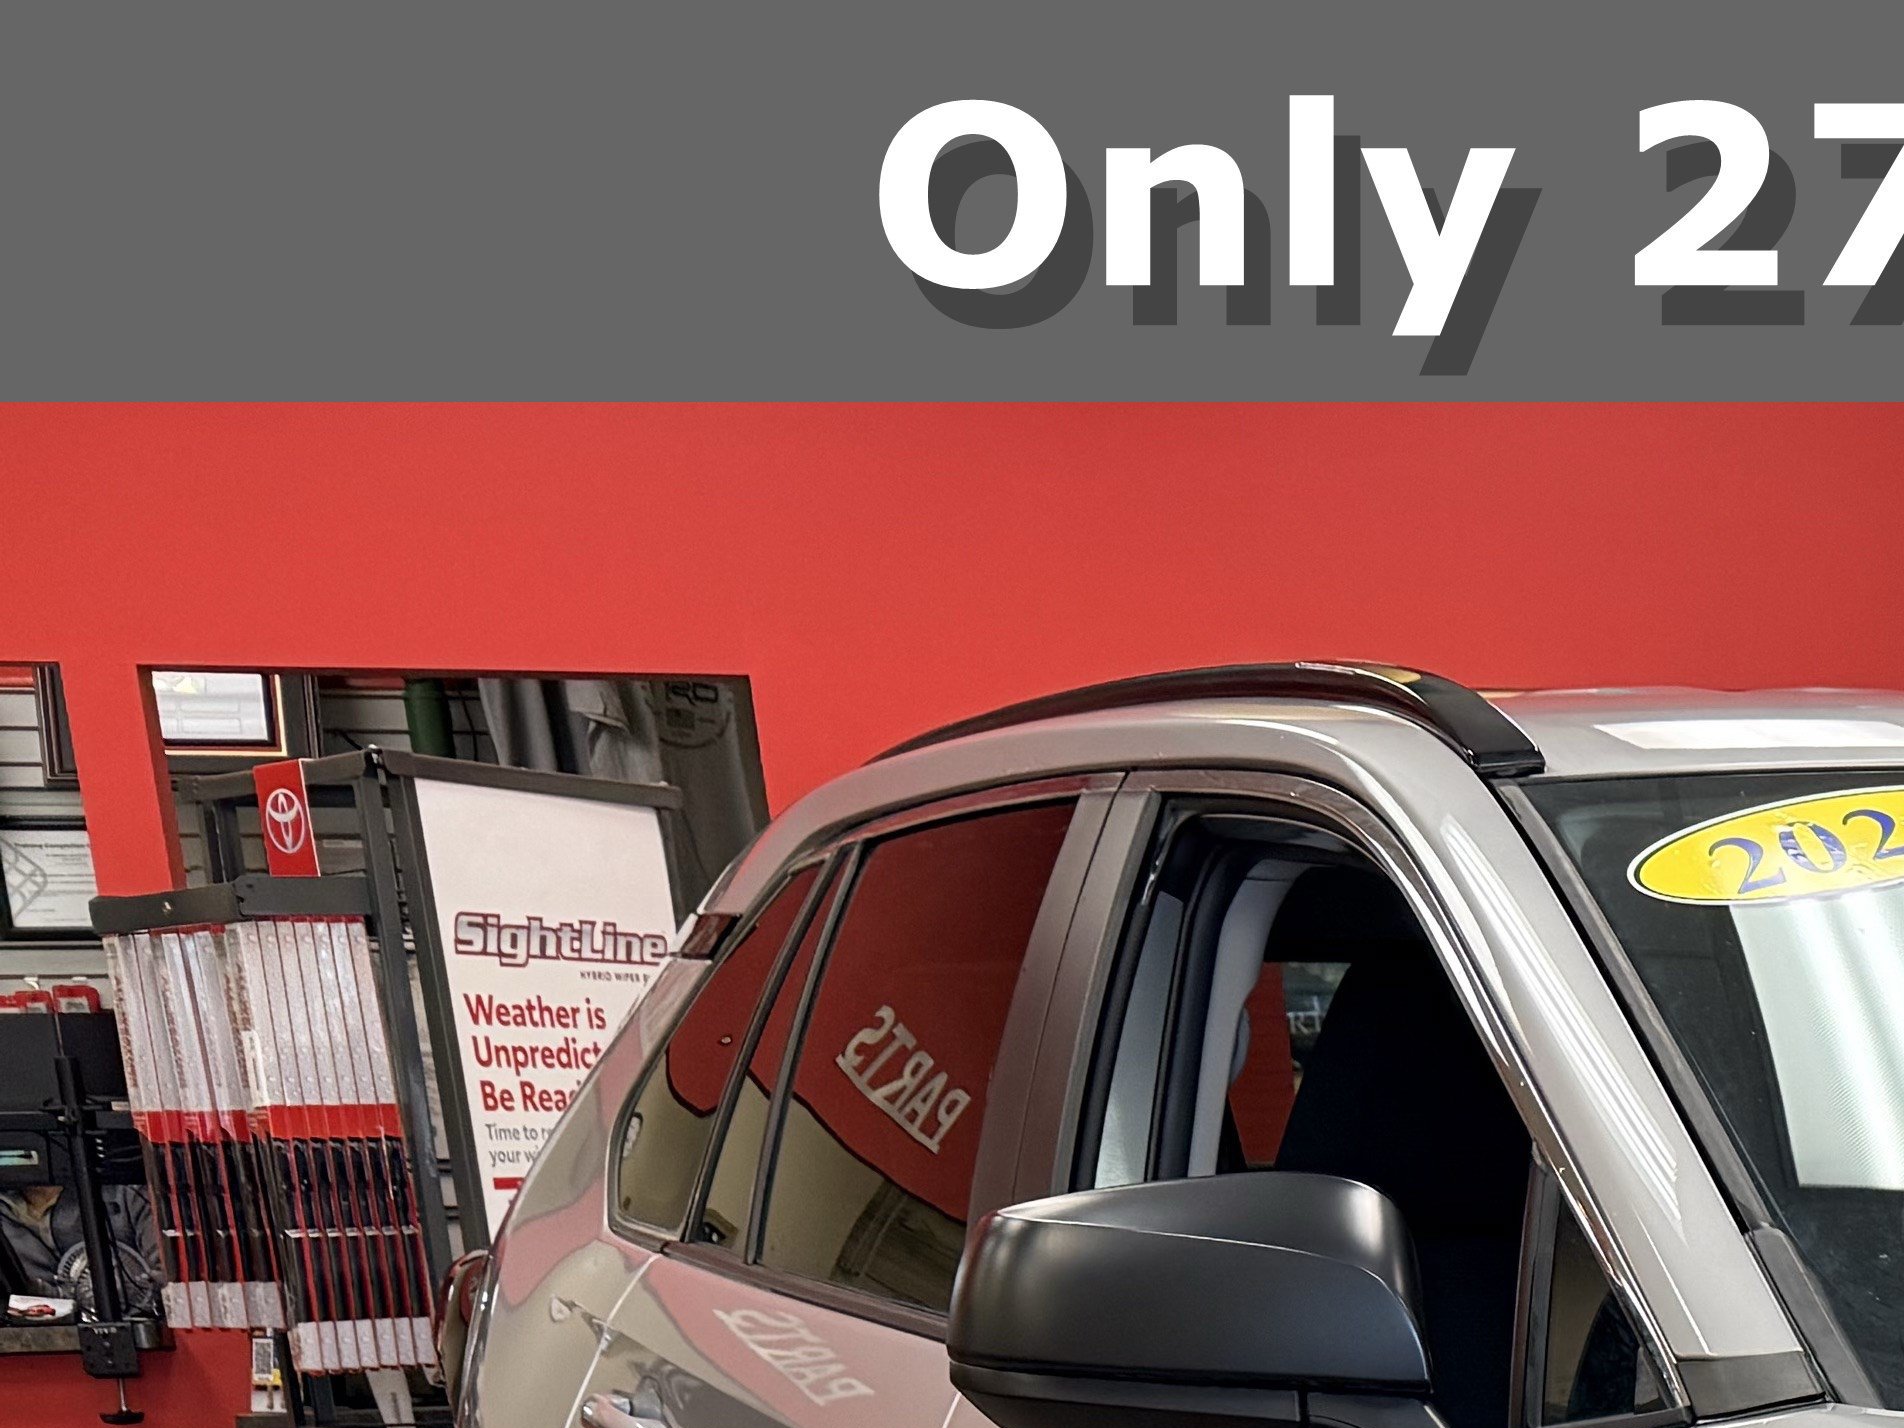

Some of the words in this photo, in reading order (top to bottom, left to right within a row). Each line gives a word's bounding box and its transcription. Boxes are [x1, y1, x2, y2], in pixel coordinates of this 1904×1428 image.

[454, 911, 668, 967] SightLine
[463, 994, 579, 1030] Weather
[585, 997, 607, 1030] is
[471, 1036, 602, 1076] Unpredict
[480, 1080, 515, 1112] Be
[520, 1080, 578, 1112] Rea
[485, 1123, 519, 1141] Time
[522, 1125, 539, 1141] to
[489, 1150, 523, 1167] your
